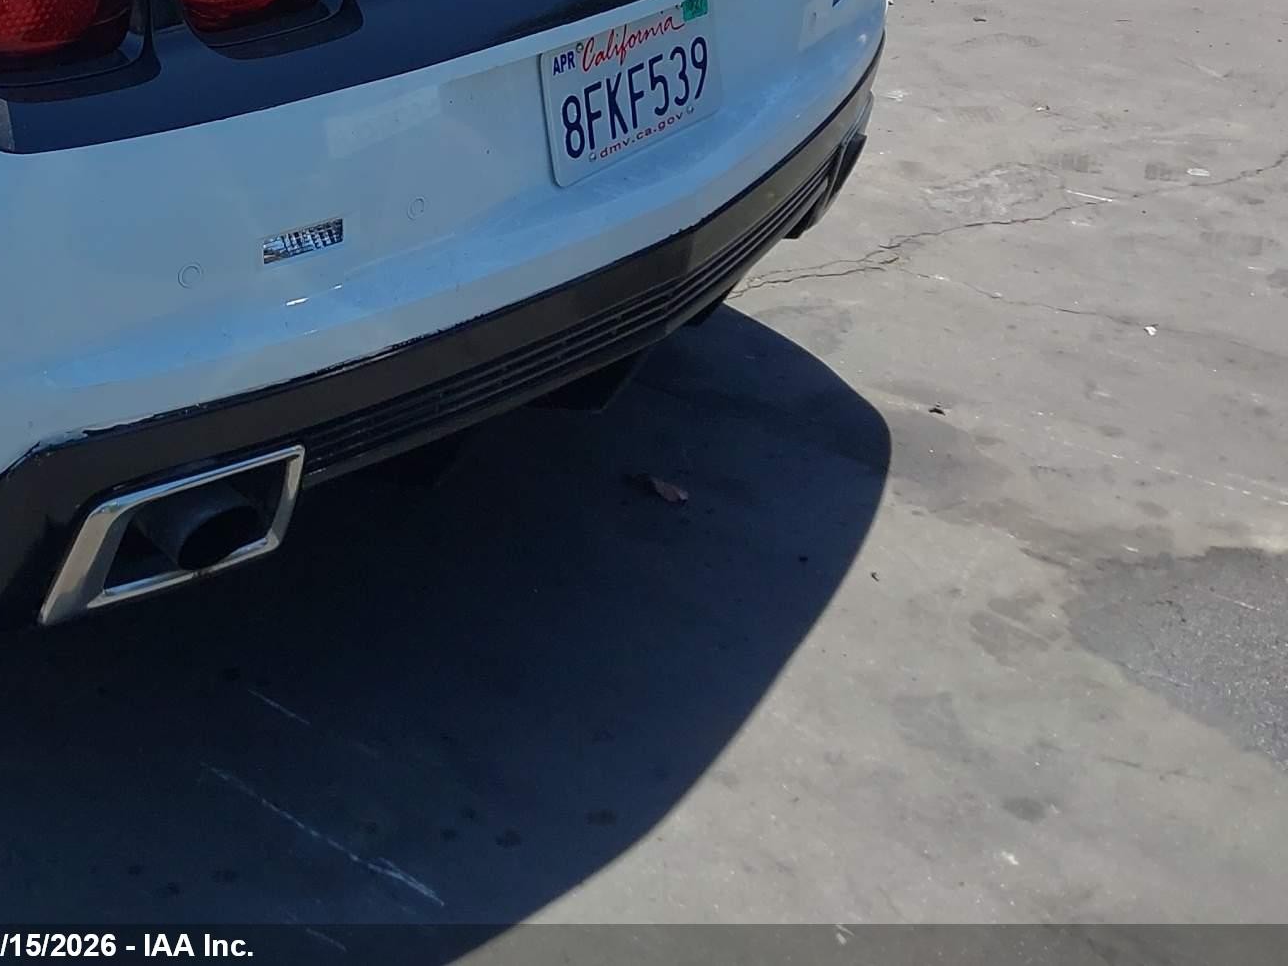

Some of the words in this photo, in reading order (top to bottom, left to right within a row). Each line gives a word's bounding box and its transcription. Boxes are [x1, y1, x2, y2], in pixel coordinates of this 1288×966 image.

[552, 50, 576, 76] APR
[581, 14, 686, 73] California
[561, 36, 708, 159] 8FKF539
[599, 111, 684, 159] dmv.ca.gov
